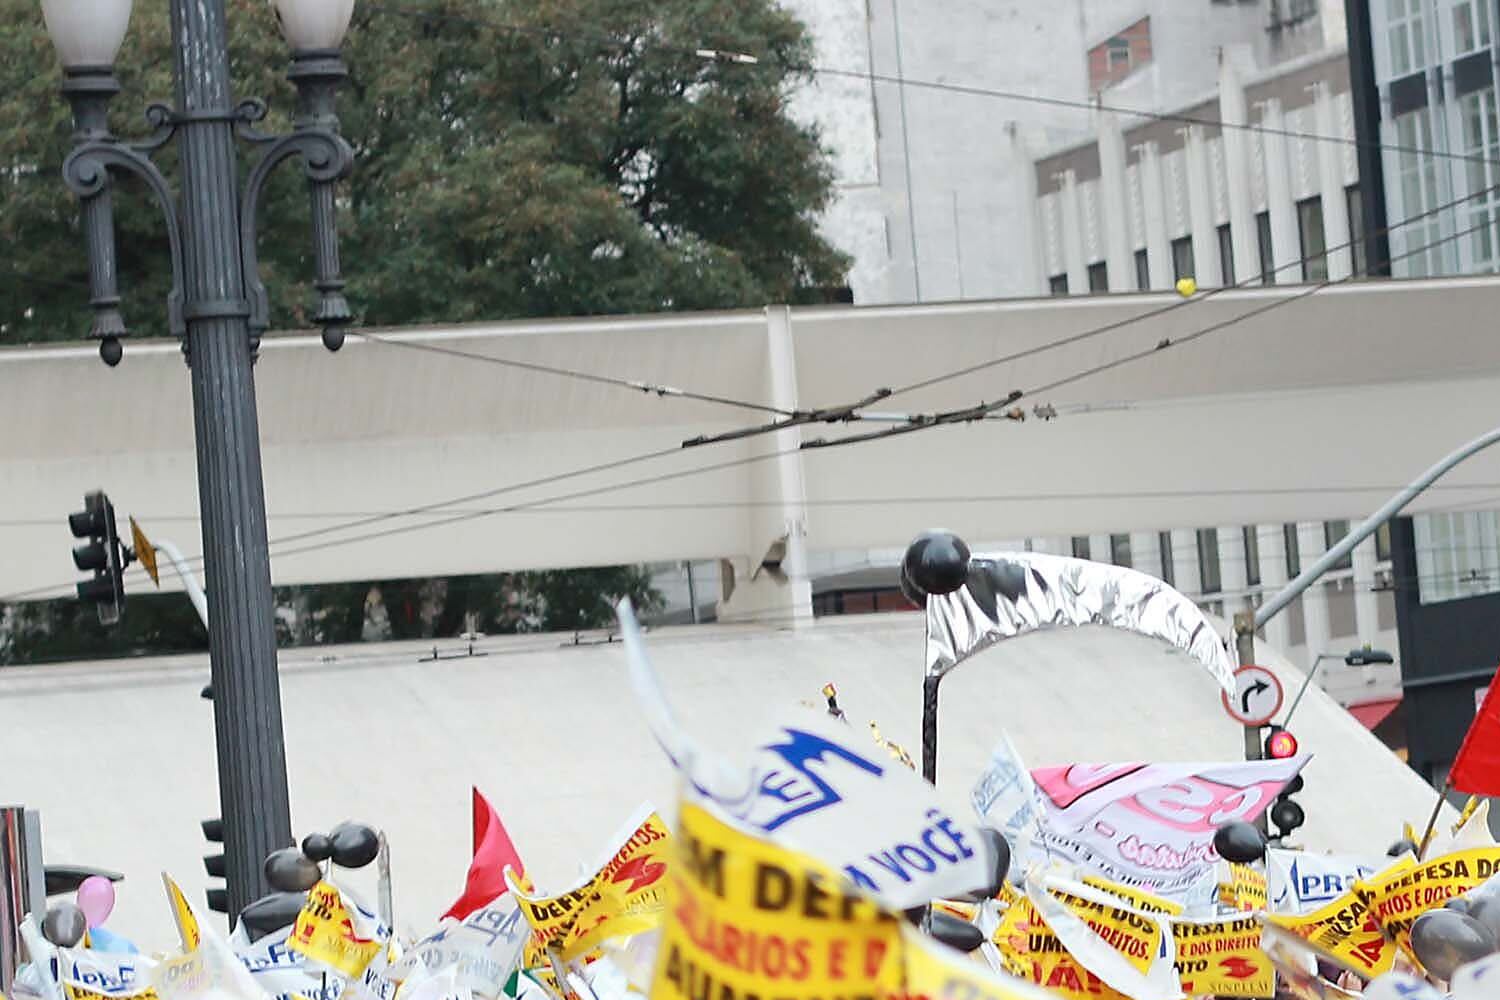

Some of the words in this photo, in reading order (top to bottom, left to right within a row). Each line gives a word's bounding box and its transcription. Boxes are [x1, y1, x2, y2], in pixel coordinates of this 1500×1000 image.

[868, 808, 974, 882] VOCÊ
[1111, 908, 1154, 935] DOS
[1190, 941, 1213, 958] DOS
